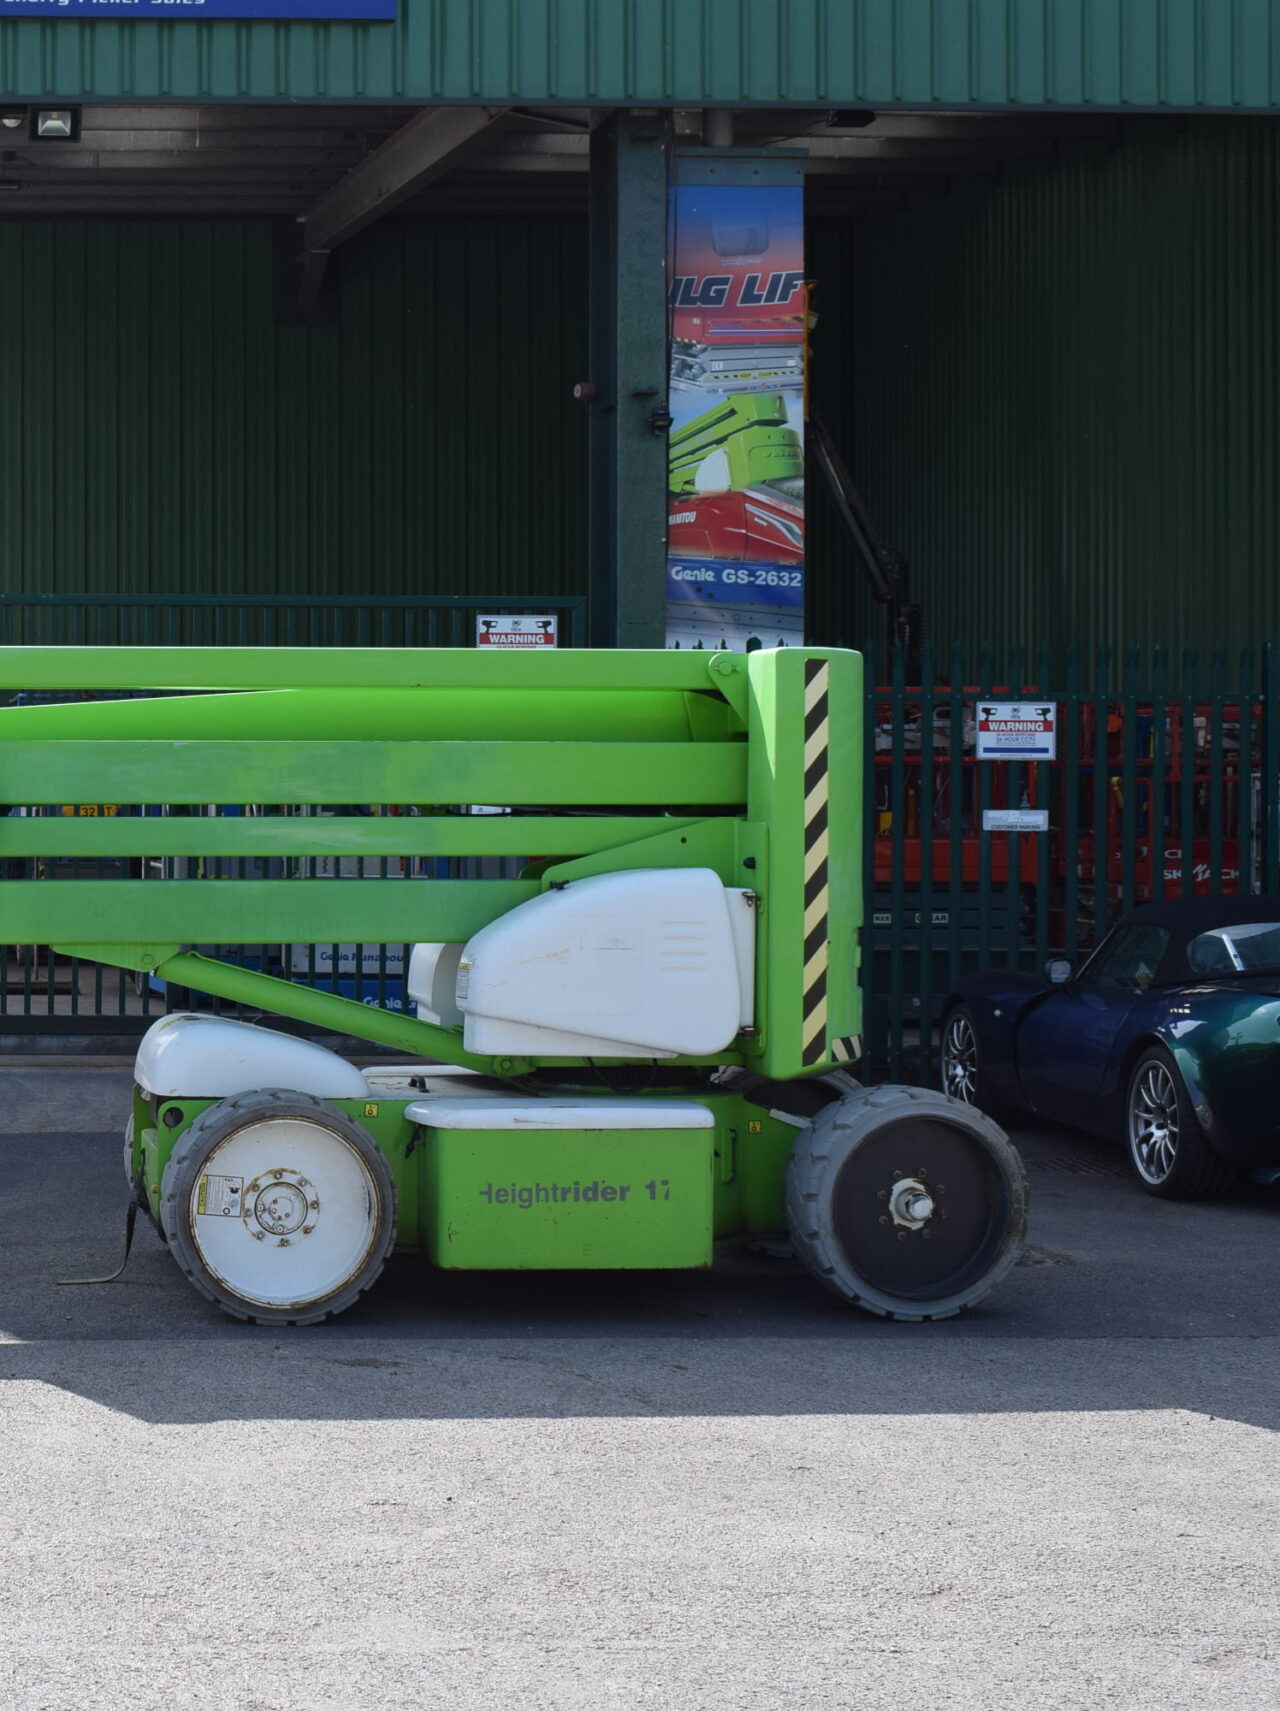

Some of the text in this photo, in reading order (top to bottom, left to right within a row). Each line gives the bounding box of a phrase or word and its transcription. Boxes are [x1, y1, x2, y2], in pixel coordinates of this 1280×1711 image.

[671, 566, 802, 587] Genie GS-2632
[489, 634, 544, 644] WARNING
[988, 721, 1044, 731] WARNING
